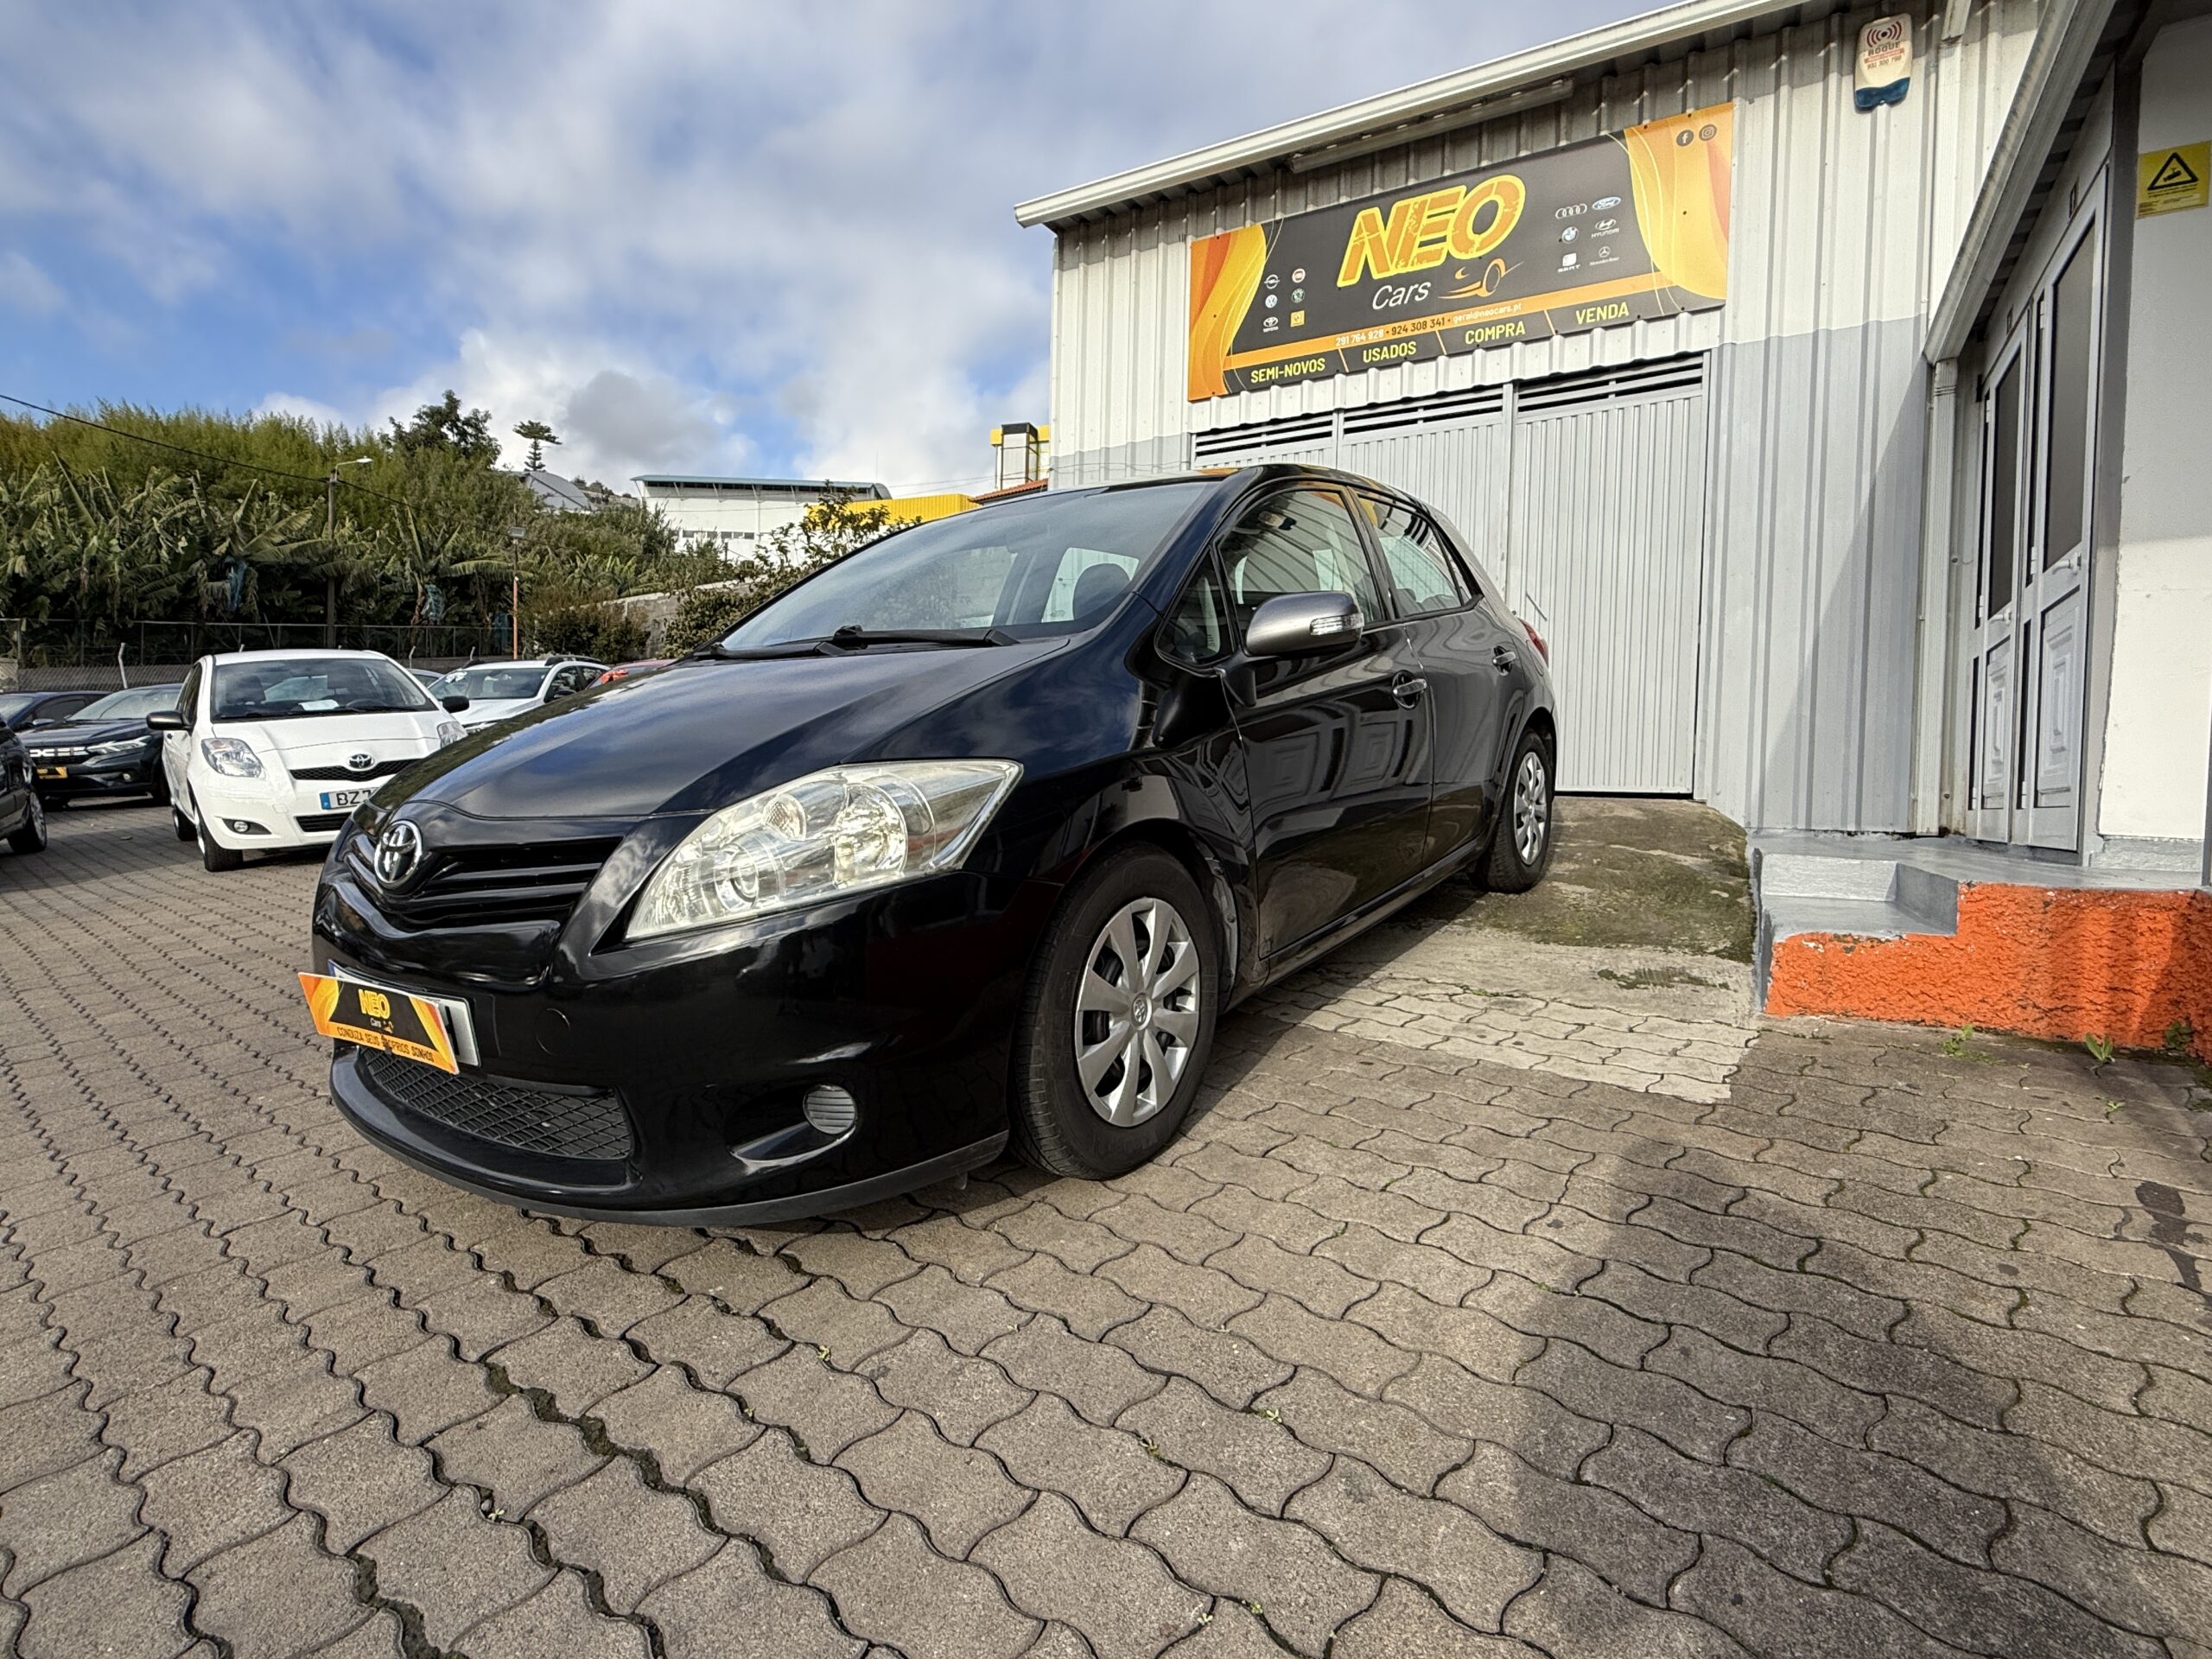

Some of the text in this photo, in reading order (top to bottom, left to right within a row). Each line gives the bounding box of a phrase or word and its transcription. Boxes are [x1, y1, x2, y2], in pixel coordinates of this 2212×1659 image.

[1338, 175, 1526, 288] NEO
[1372, 281, 1431, 311] Cars
[1336, 302, 1522, 346] 291 764 928 924 308 341 geral@neocars.pt
[1576, 302, 1630, 325] VENDA
[1465, 321, 1526, 345] COMPRA
[1363, 341, 1417, 363] USADOS
[1250, 358, 1325, 384] SEMI-NOVOS
[359, 988, 391, 1020] NEO
[365, 1032, 380, 1046] SEUS
